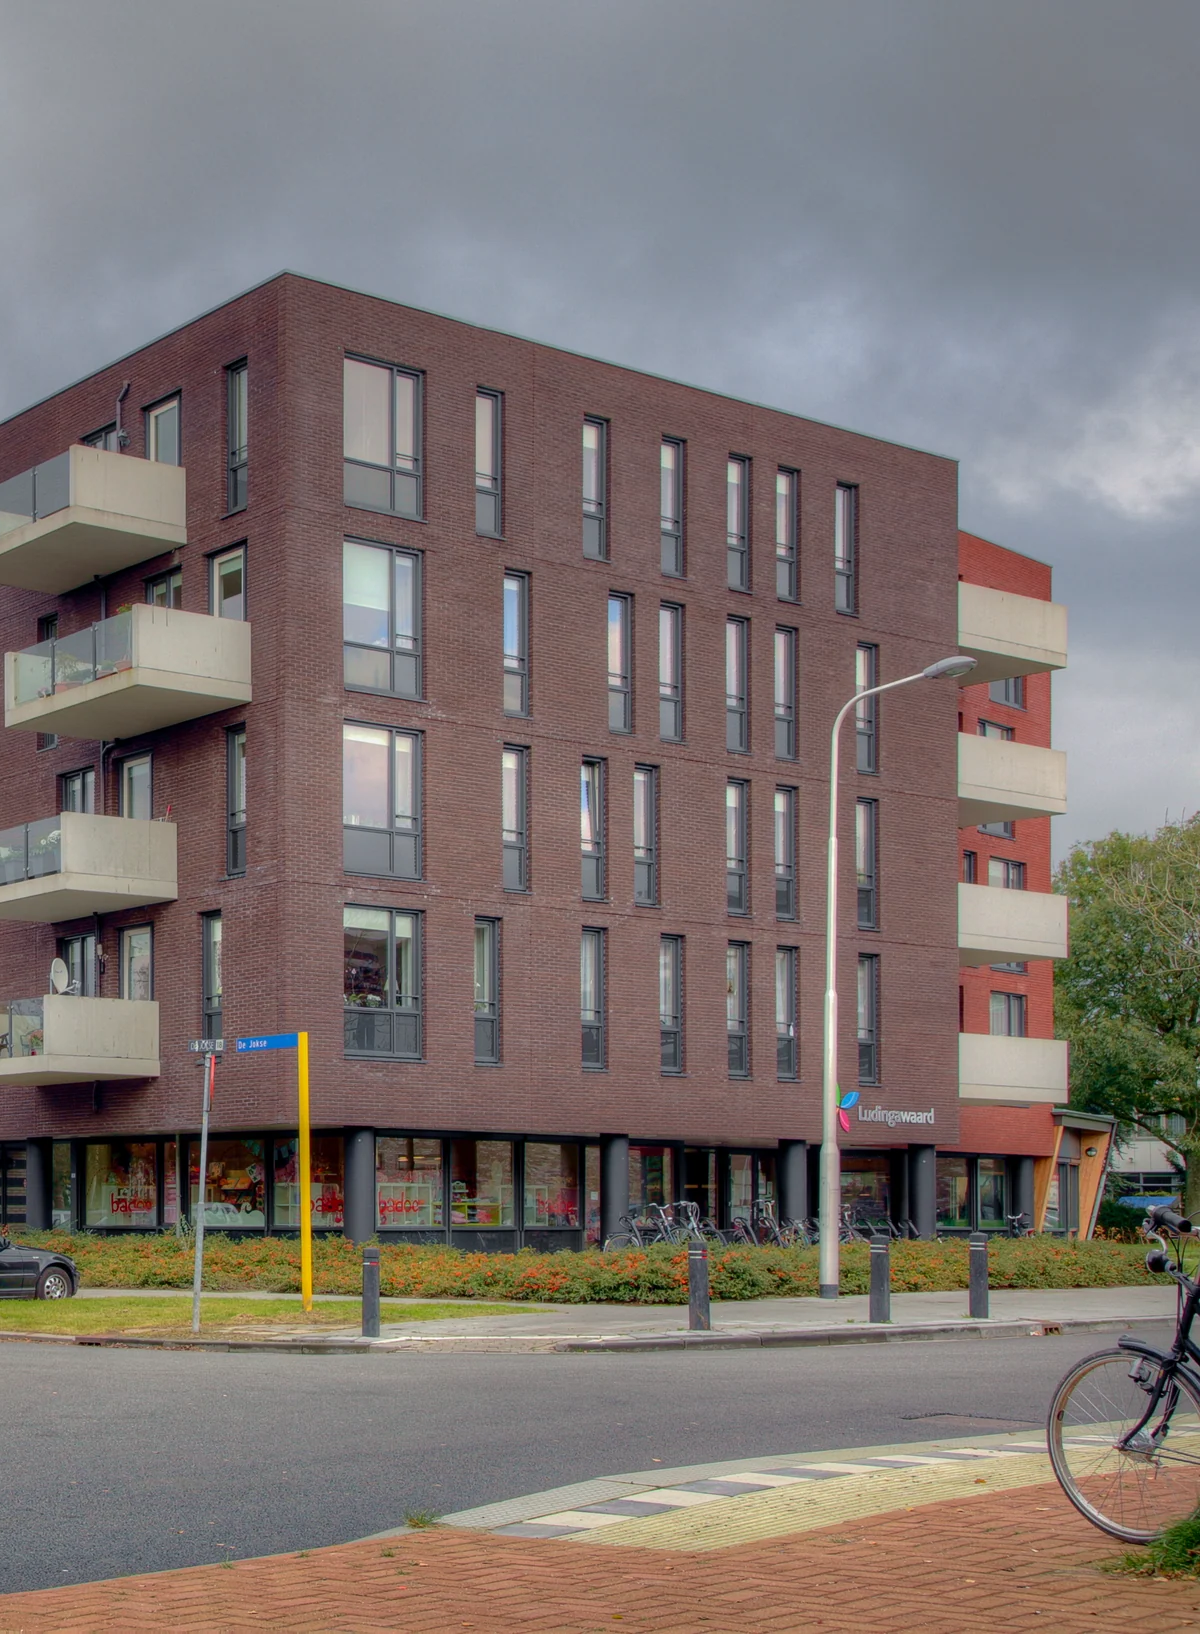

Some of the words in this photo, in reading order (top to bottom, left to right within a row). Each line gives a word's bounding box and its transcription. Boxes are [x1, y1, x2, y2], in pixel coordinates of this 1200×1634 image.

[238, 1041, 246, 1049] De
[249, 1040, 267, 1048] Jokse
[858, 1105, 935, 1128] Ludingawaard
